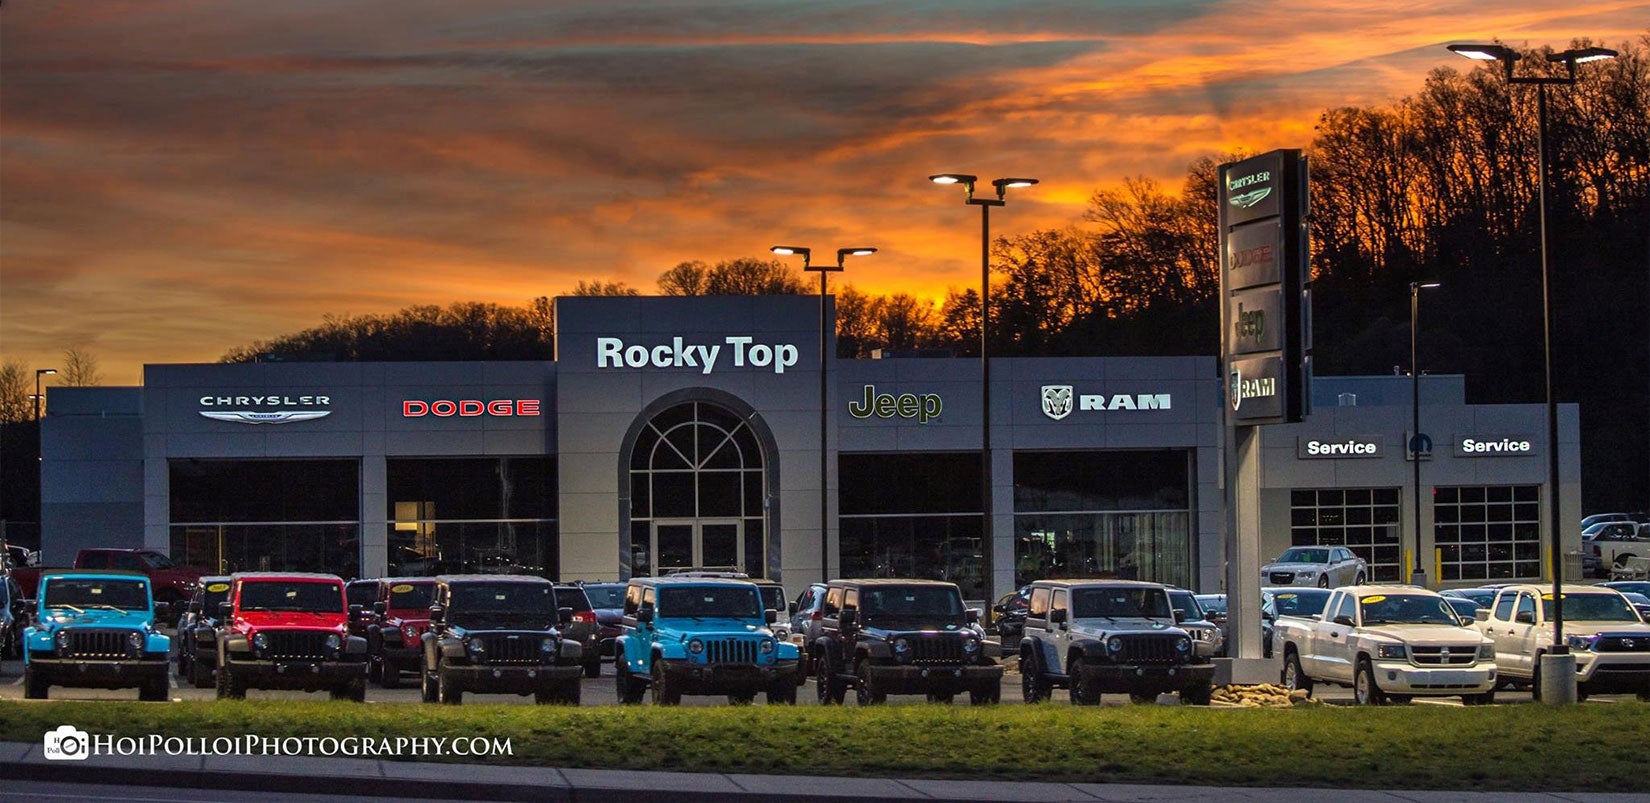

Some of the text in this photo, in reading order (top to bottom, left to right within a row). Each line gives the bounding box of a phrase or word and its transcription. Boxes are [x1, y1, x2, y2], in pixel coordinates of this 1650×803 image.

[1235, 302, 1264, 343] Jeep
[597, 336, 799, 374] Rocky Top
[1241, 378, 1275, 398] RAM
[199, 396, 330, 406] CHRYSLER
[403, 400, 540, 417] DODGE
[848, 384, 943, 424] Jeep
[1079, 394, 1171, 410] RAM
[1307, 440, 1377, 455] Service
[1462, 438, 1530, 453] Service
